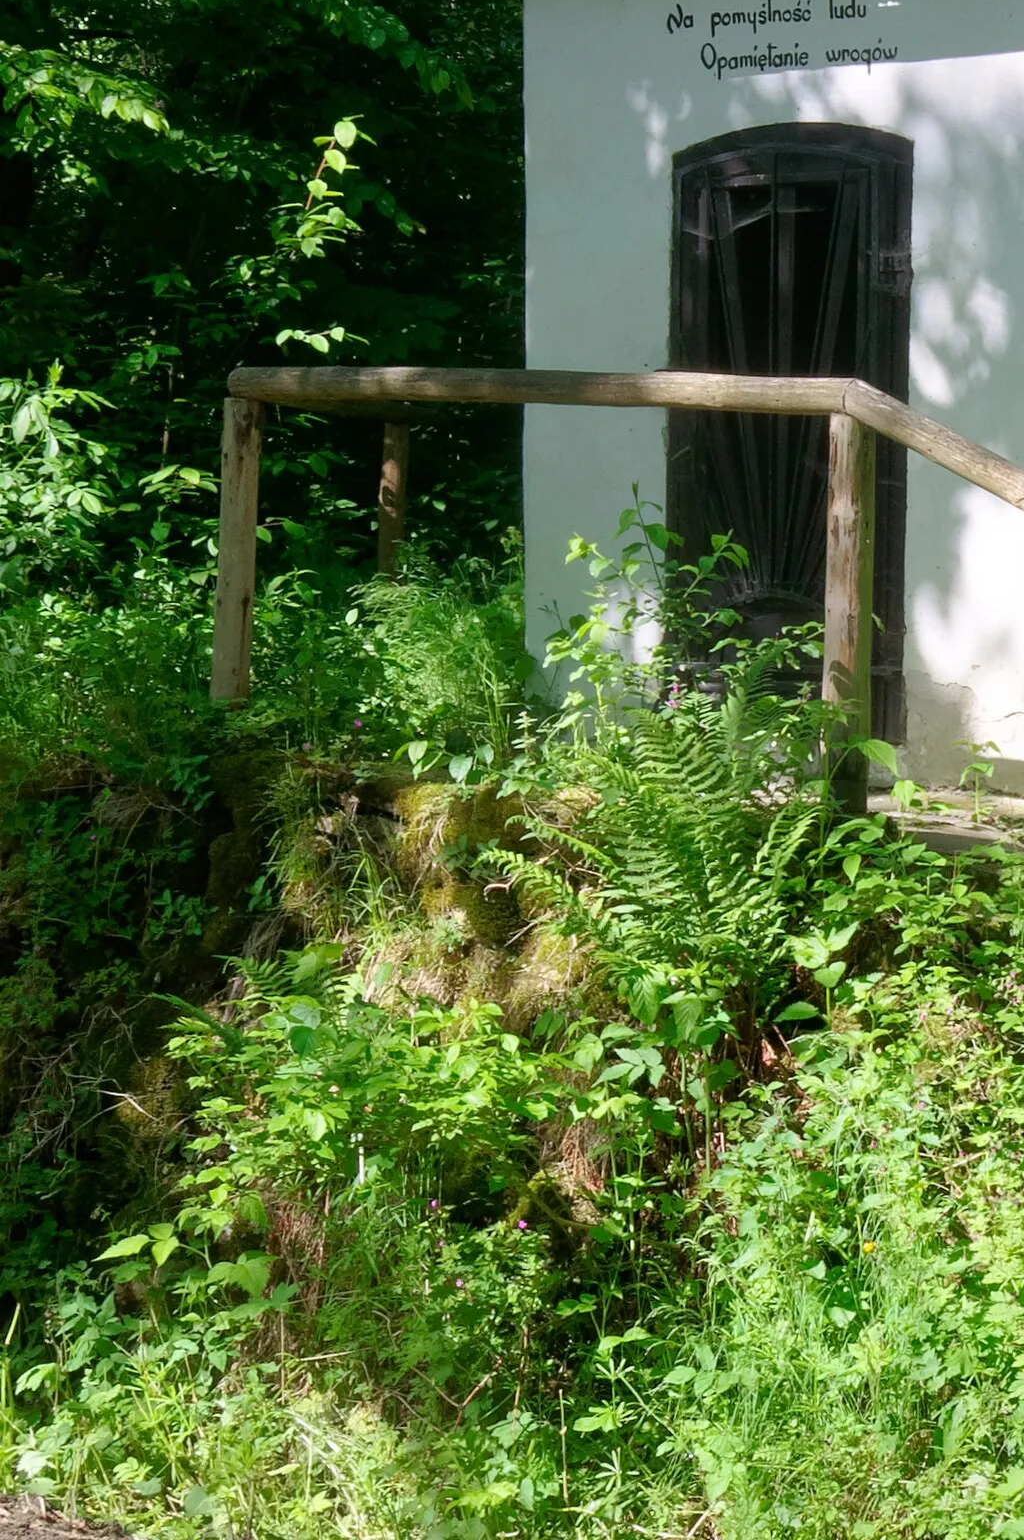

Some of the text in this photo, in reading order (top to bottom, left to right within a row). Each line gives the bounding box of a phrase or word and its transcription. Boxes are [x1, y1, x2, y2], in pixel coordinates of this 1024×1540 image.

[666, 4, 694, 33] Na
[710, 0, 812, 37] pomyślność
[700, 38, 898, 80] Opamiętanie wrogów
